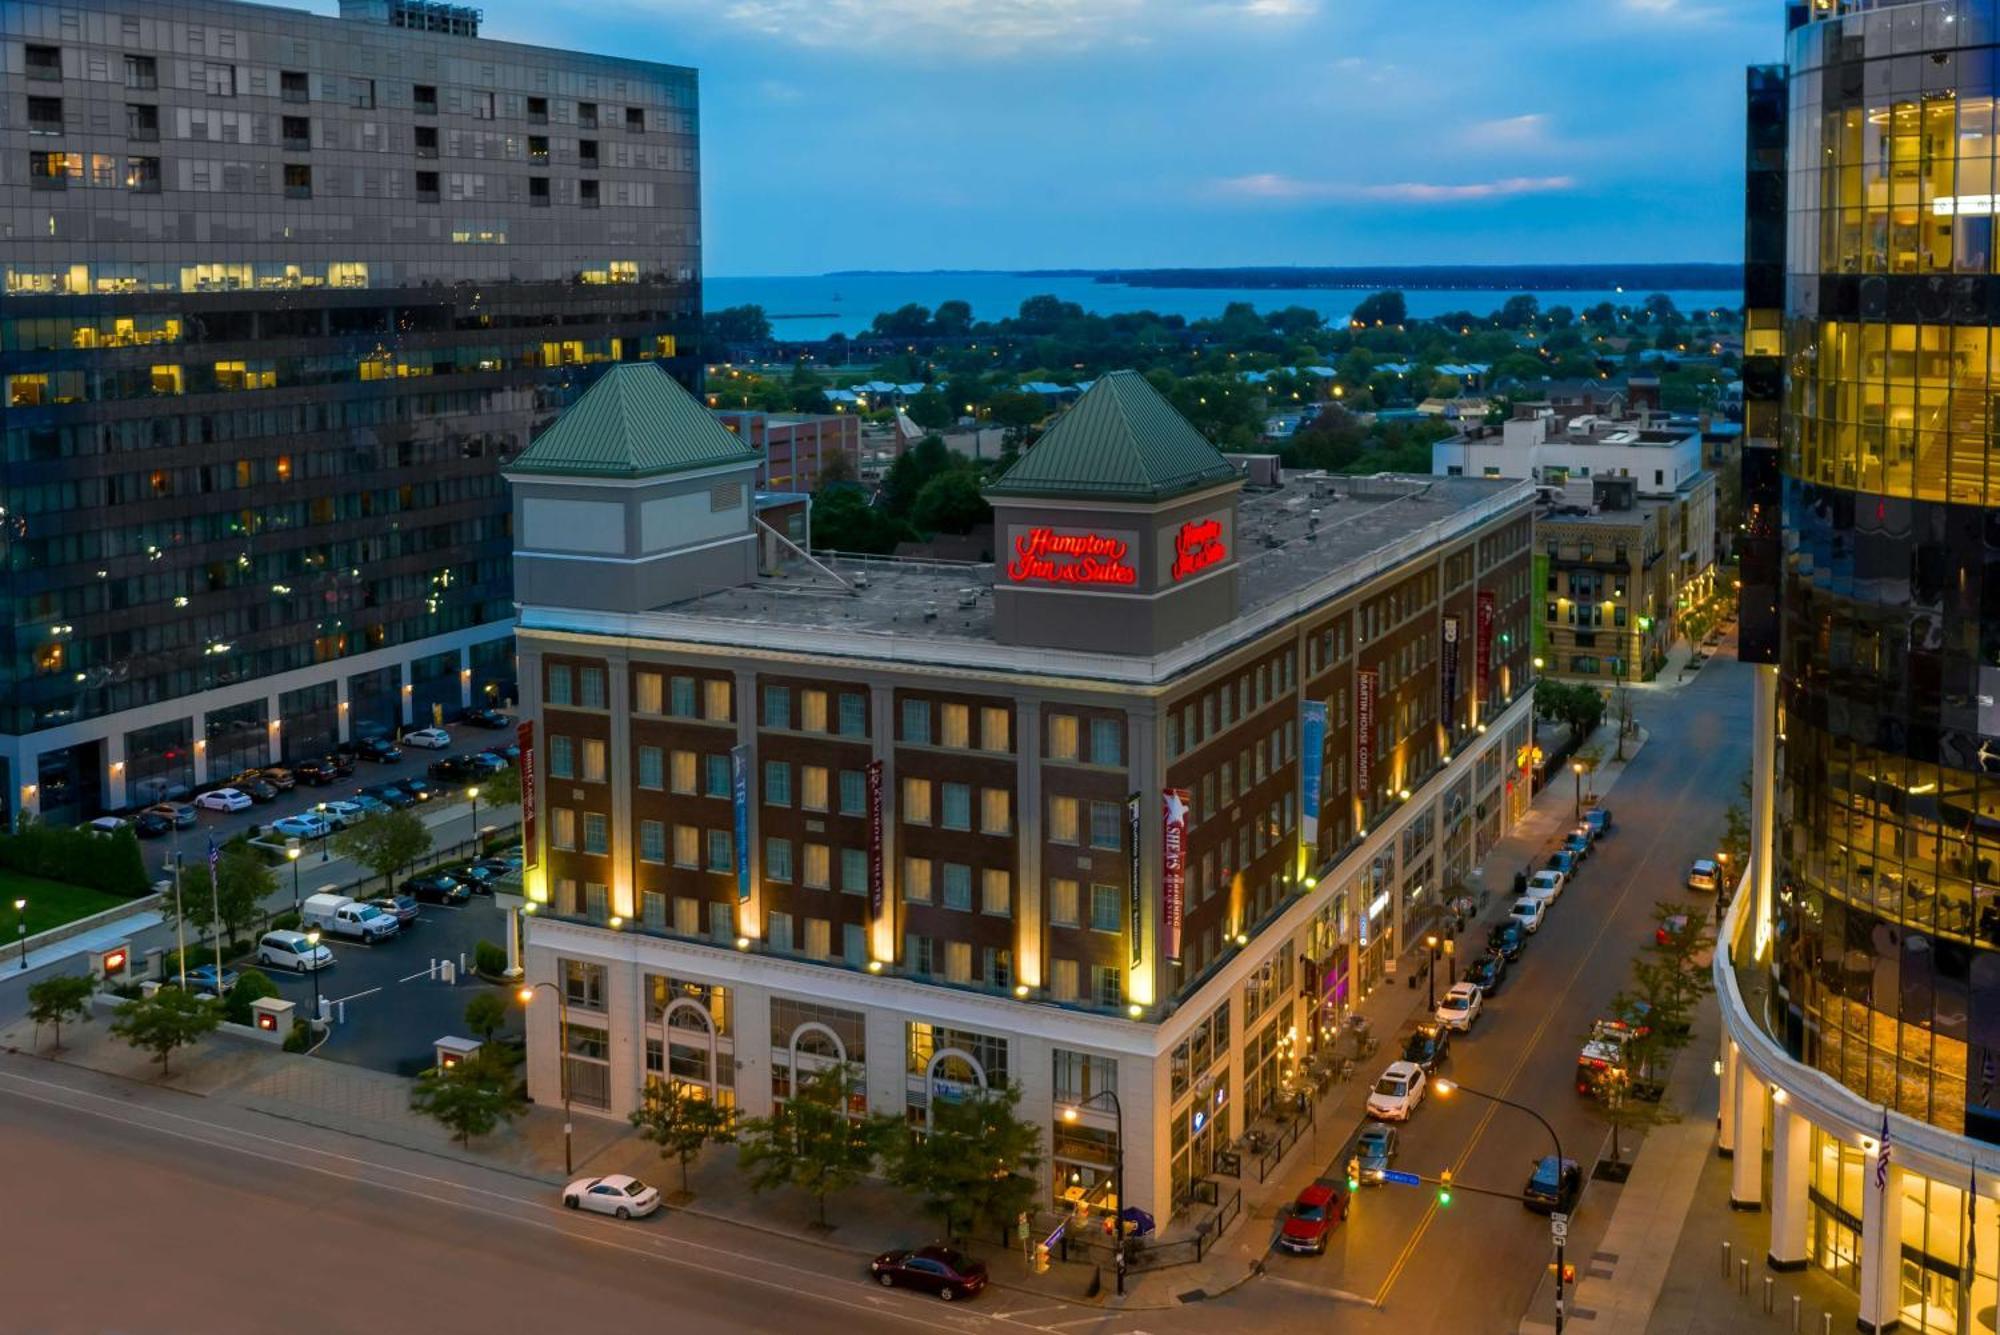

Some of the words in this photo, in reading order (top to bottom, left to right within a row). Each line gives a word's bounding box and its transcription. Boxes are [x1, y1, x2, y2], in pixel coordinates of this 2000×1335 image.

[1015, 528, 1127, 559] Hampton
[1008, 555, 1063, 580] Inn
[1075, 557, 1136, 584] Suites
[1359, 674, 1368, 709] MARTIN
[1359, 712, 1368, 744] HOUSE
[1359, 747, 1369, 791] COMPLEX
[1166, 826, 1181, 870] SHEA'S
